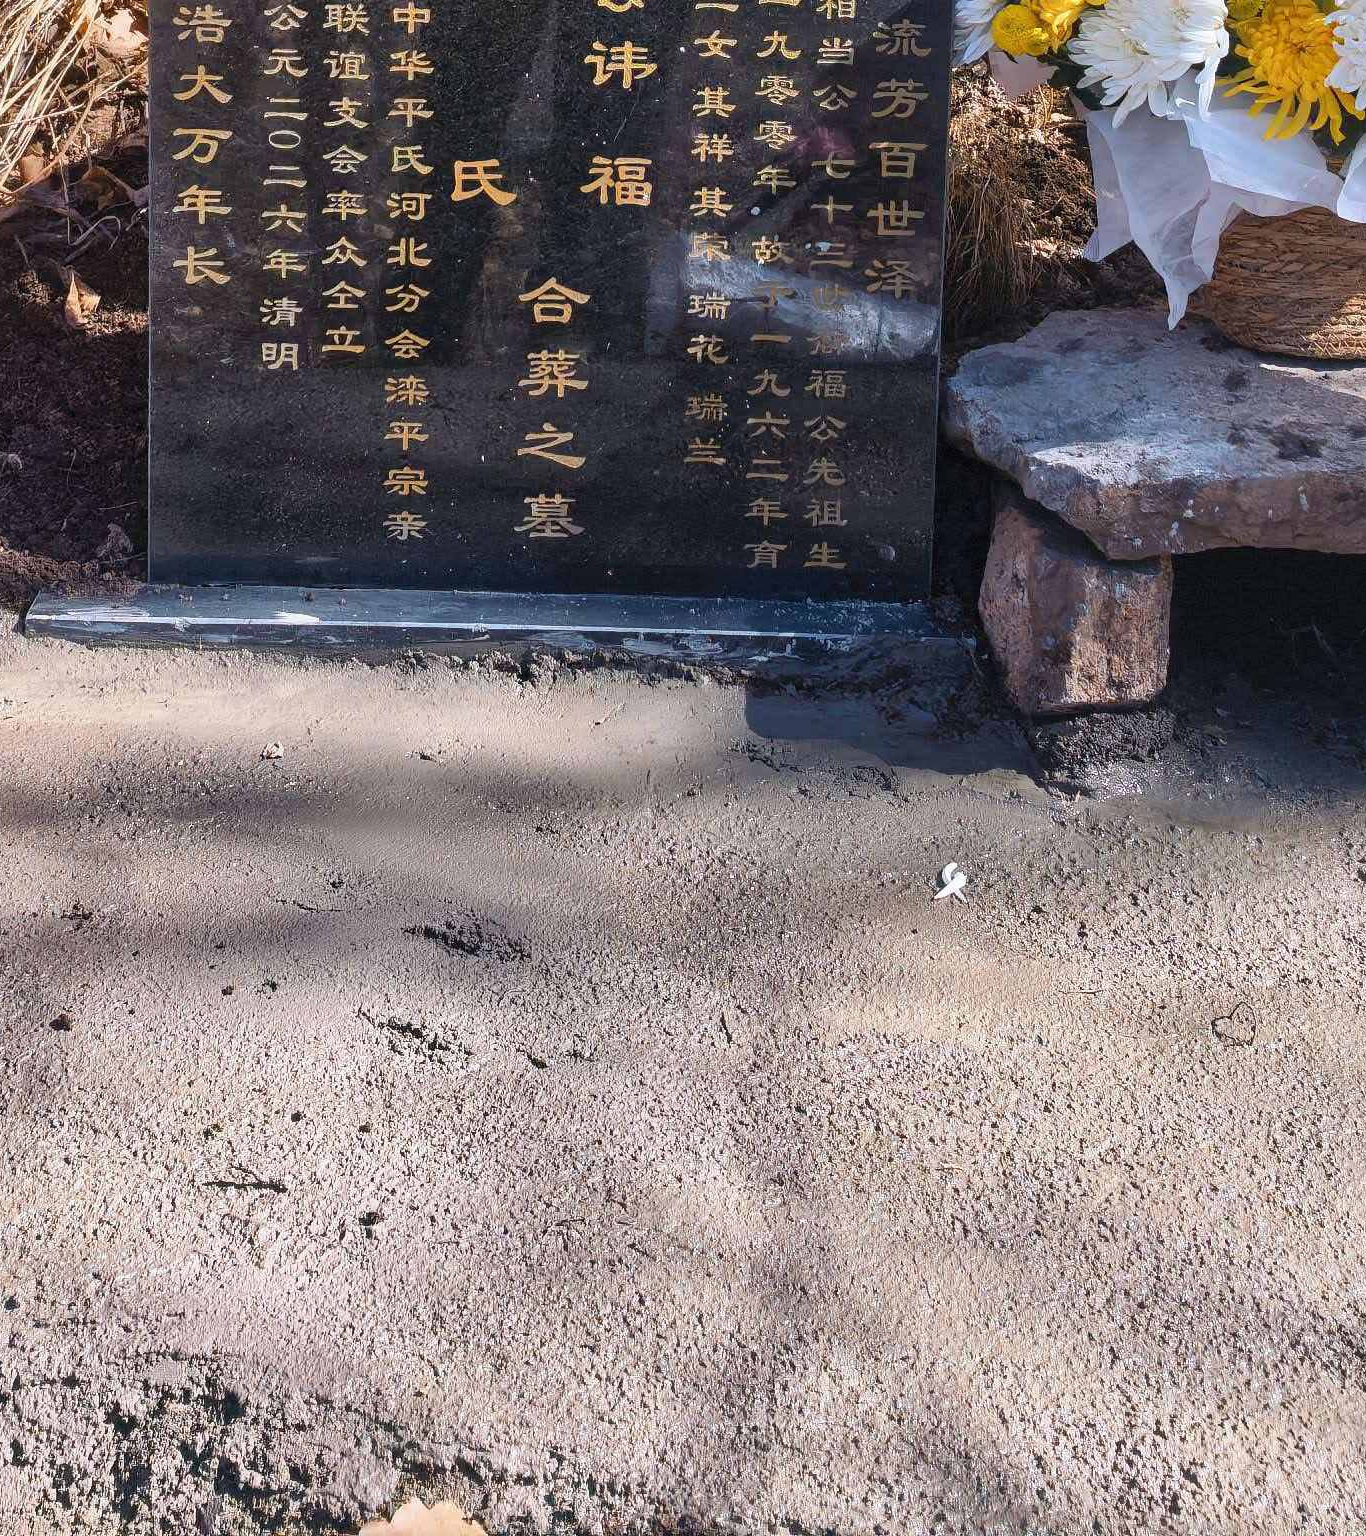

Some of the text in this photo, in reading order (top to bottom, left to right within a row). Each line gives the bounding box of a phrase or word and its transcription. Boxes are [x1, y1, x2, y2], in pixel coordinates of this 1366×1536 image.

[322, 4, 371, 353] 联谊支会率众仝立
[383, 1, 435, 541] 中华平氏河北分会滦平宗亲
[514, 277, 590, 538] 合葬之墓
